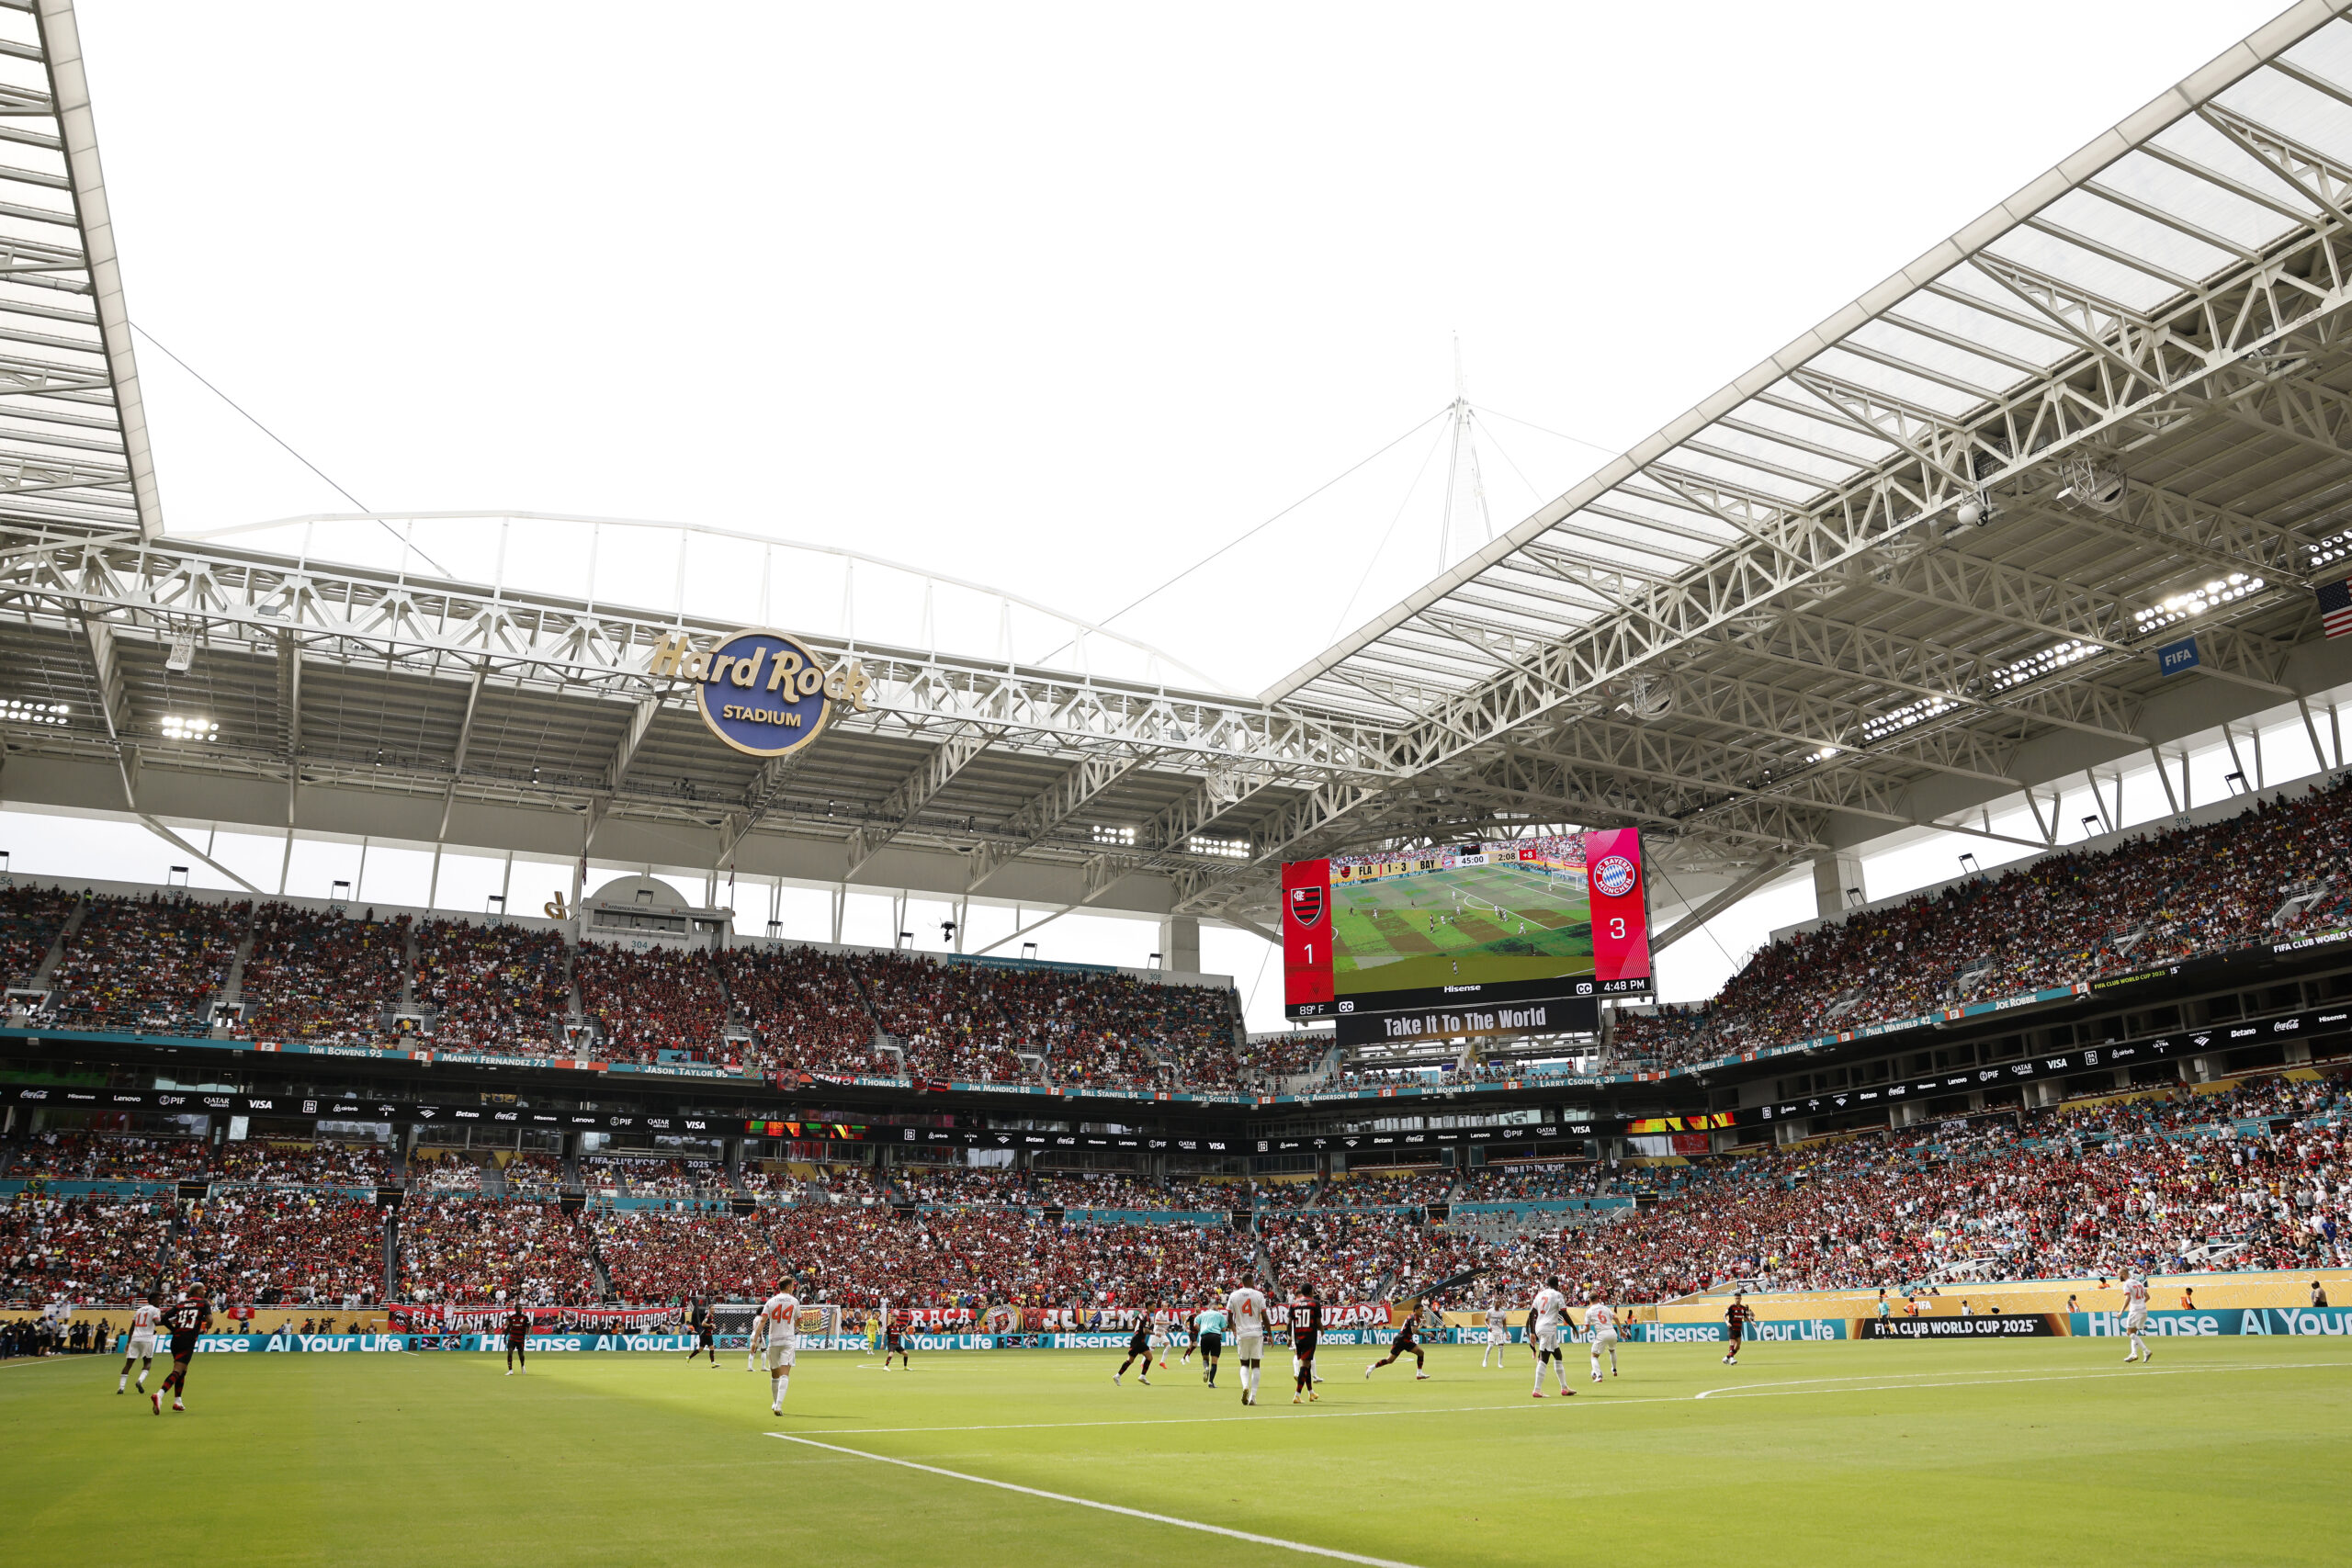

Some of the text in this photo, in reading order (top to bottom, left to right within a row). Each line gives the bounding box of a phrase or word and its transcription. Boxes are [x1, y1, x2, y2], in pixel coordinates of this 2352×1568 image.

[2165, 649, 2192, 667] FIFA
[648, 634, 871, 712] Hard Rock
[722, 705, 801, 728] STADIUM
[2176, 818, 2190, 827] 316
[1461, 855, 1484, 864] 45:00
[1498, 852, 1516, 862] 2:08
[1359, 865, 1372, 875] FLA
[1419, 859, 1435, 870] BAY
[1604, 858, 1632, 873] BAYERN
[1610, 918, 1625, 939] 3
[631, 940, 649, 950] 304
[2274, 942, 2292, 953] FIFA
[2293, 938, 2314, 950] CLUB
[2316, 931, 2347, 945] WORLD
[1304, 943, 1313, 964] 1
[1444, 984, 1481, 993] Hisense
[1577, 984, 1591, 993] CC
[1604, 979, 1645, 991] 4:48 PM
[2094, 982, 2106, 990] FIFA
[2107, 979, 2120, 987] CLUB
[2120, 976, 2139, 985] WORLD
[1317, 1004, 1324, 1013] F
[1340, 1002, 1352, 1010] CC
[1996, 996, 2037, 1010] JOE ROBBIE
[1385, 1007, 1547, 1036] Take It To The World
[2319, 1013, 2347, 1023] Hisense
[1866, 1016, 1931, 1036] PAUL WARFIELD 42
[2274, 1020, 2299, 1032] Coca-Cola
[2231, 1027, 2256, 1038] Betano
[308, 1045, 383, 1058] TIM BOWENS 95
[1770, 1039, 1823, 1056] JIM LANGER 62
[442, 1054, 547, 1067] MANNY FERNANDEZ 75
[1717, 1059, 1724, 1067] 12
[2046, 1057, 2067, 1069] VISA
[644, 1066, 713, 1077] JASON TAYLOR
[2011, 1063, 2032, 1074] QATAR
[1987, 1070, 1998, 1079] PIF
[861, 1077, 896, 1087] THOMAS
[899, 1079, 910, 1089] 54
[1540, 1076, 1615, 1088] LARRY CSONKA 39
[1948, 1076, 1967, 1085] Lenovo
[967, 1084, 1030, 1094] JIM MANDICH 88
[1436, 1086, 1462, 1094] MOORE
[1464, 1084, 1476, 1092] 89
[114, 1094, 141, 1102] Lenovo
[170, 1096, 186, 1105] PIF
[204, 1096, 230, 1105] QATAR
[1097, 1090, 1126, 1099] STANFILL
[1128, 1091, 1138, 1100] 84
[1192, 1094, 1207, 1102] JAKE
[1209, 1095, 1229, 1103] SCOTT
[1295, 1091, 1358, 1102] DICK ANDERSON 40
[1860, 1091, 1877, 1100] Betano
[248, 1100, 273, 1110] VISA
[648, 1118, 670, 1126] QATAR
[684, 1121, 706, 1129] VISA
[1536, 1126, 1557, 1134] QATAR
[1570, 1125, 1591, 1134] VISA
[1208, 1142, 1226, 1150] VISA
[1504, 1166, 1519, 1174] Take
[1241, 1298, 1253, 1317] 4
[134, 1312, 148, 1326] 11
[178, 1309, 199, 1329] 43
[771, 1303, 795, 1325] 44
[1295, 1308, 1311, 1328] 50
[1597, 1310, 1607, 1325] 6
[1899, 1320, 2000, 1335] CLUB WORLD CUP
[2240, 1309, 2272, 1336] AI
[1645, 1324, 1720, 1342] Hisense
[1754, 1321, 1795, 1341] Your
[1799, 1320, 1835, 1340] Life
[265, 1335, 402, 1351] AI Your Life
[595, 1335, 673, 1351] AI Your
[910, 1334, 955, 1349] Your
[959, 1334, 992, 1349] Life
[1362, 1330, 1372, 1345] AI
